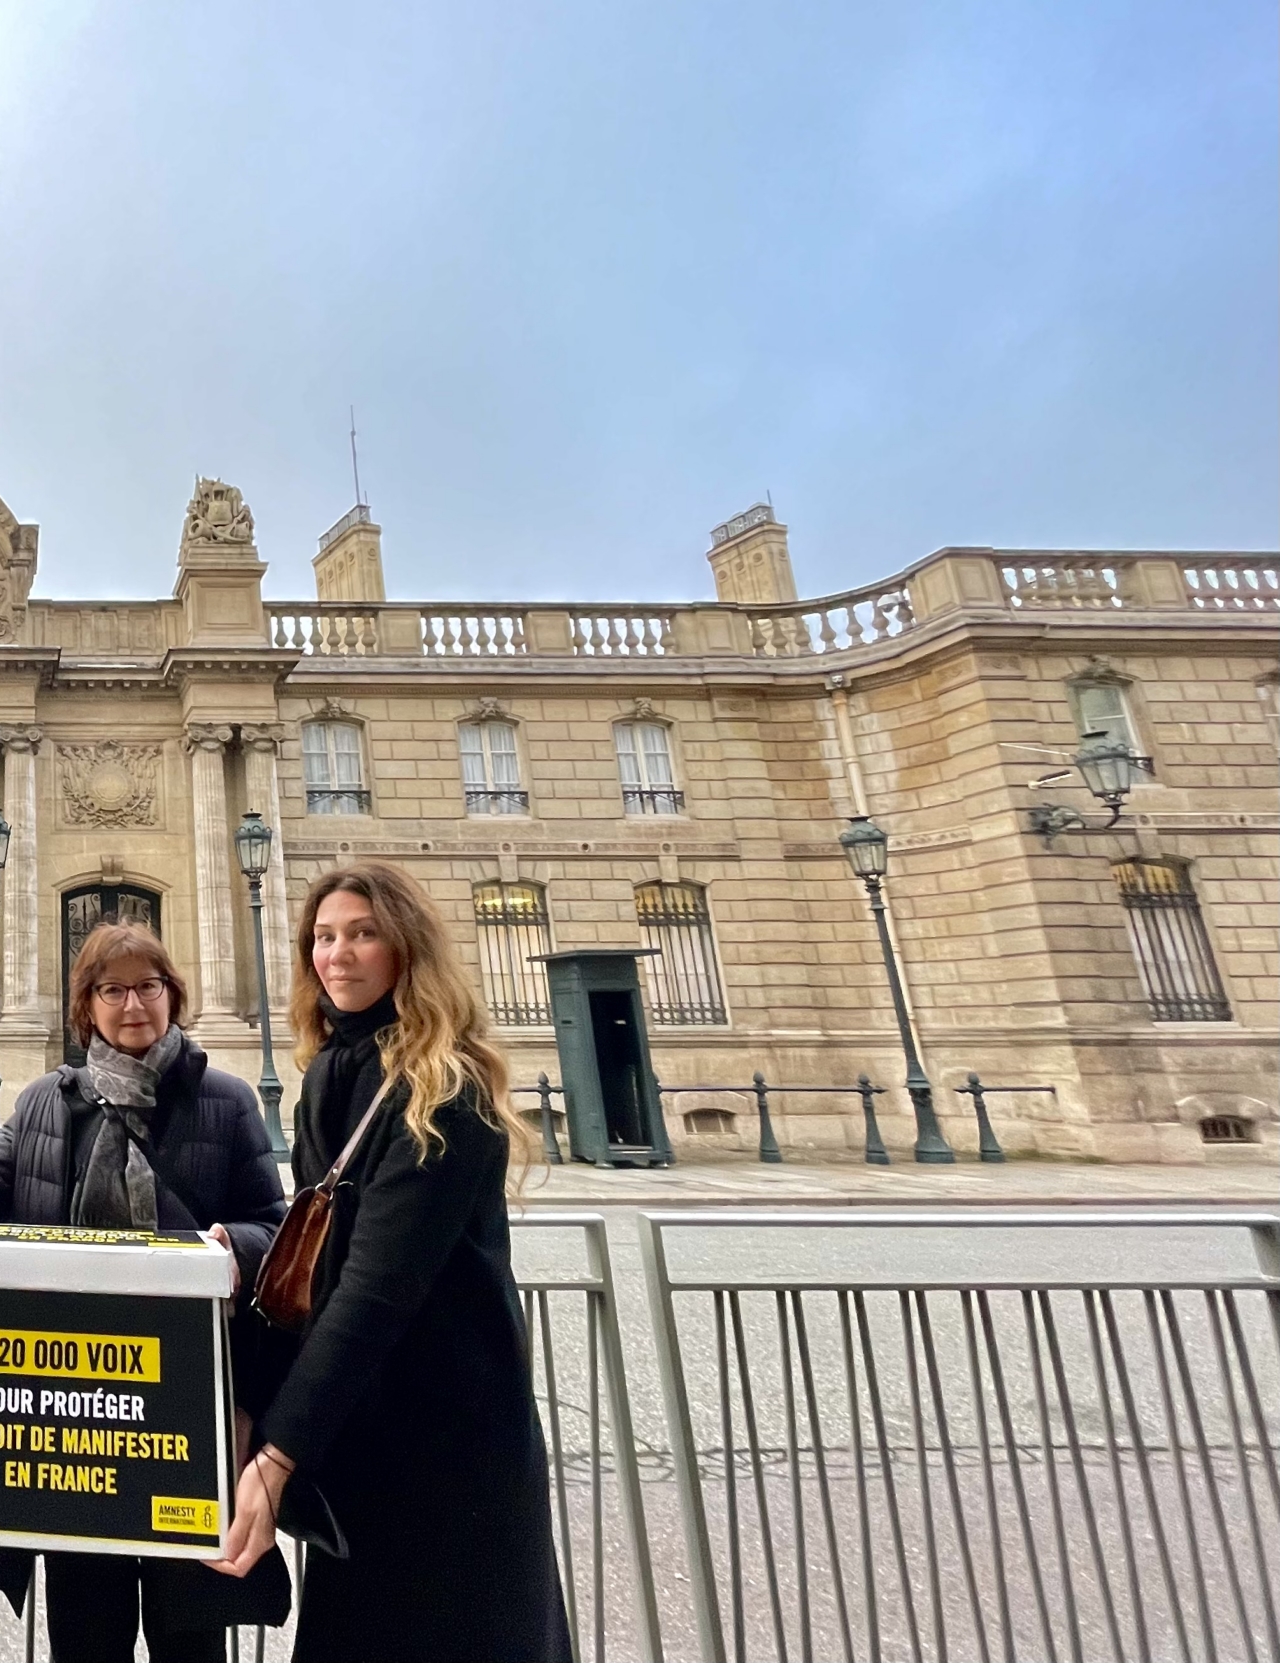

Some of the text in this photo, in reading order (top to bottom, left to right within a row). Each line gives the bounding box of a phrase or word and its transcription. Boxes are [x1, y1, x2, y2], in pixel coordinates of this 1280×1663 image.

[34, 1339, 78, 1371] 000
[87, 1342, 144, 1374] VOIX
[40, 1387, 145, 1421] PROTÉGER
[30, 1425, 56, 1452] DE
[62, 1427, 190, 1461] MANIFESTER
[5, 1461, 117, 1494] EN FRANCE
[159, 1504, 196, 1517] AMNESTY
